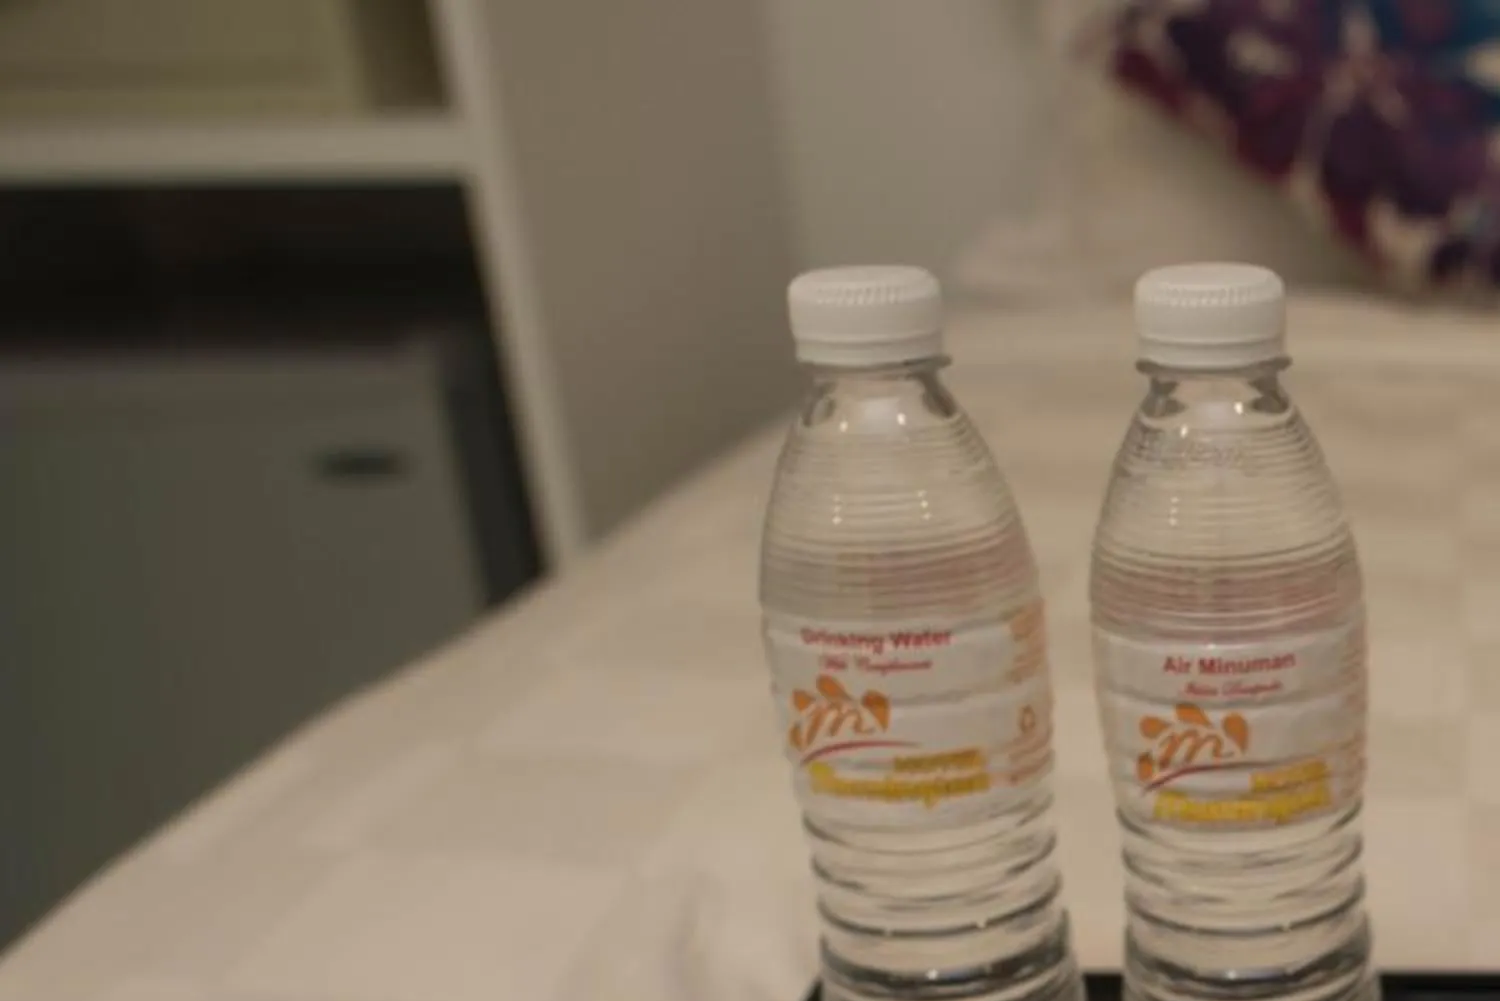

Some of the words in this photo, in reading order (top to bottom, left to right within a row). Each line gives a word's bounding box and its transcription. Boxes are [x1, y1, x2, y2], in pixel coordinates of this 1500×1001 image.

[800, 627, 885, 655] Drinking
[889, 629, 952, 650] Water
[1163, 655, 1191, 674] Air
[1198, 652, 1296, 675] Minuman
